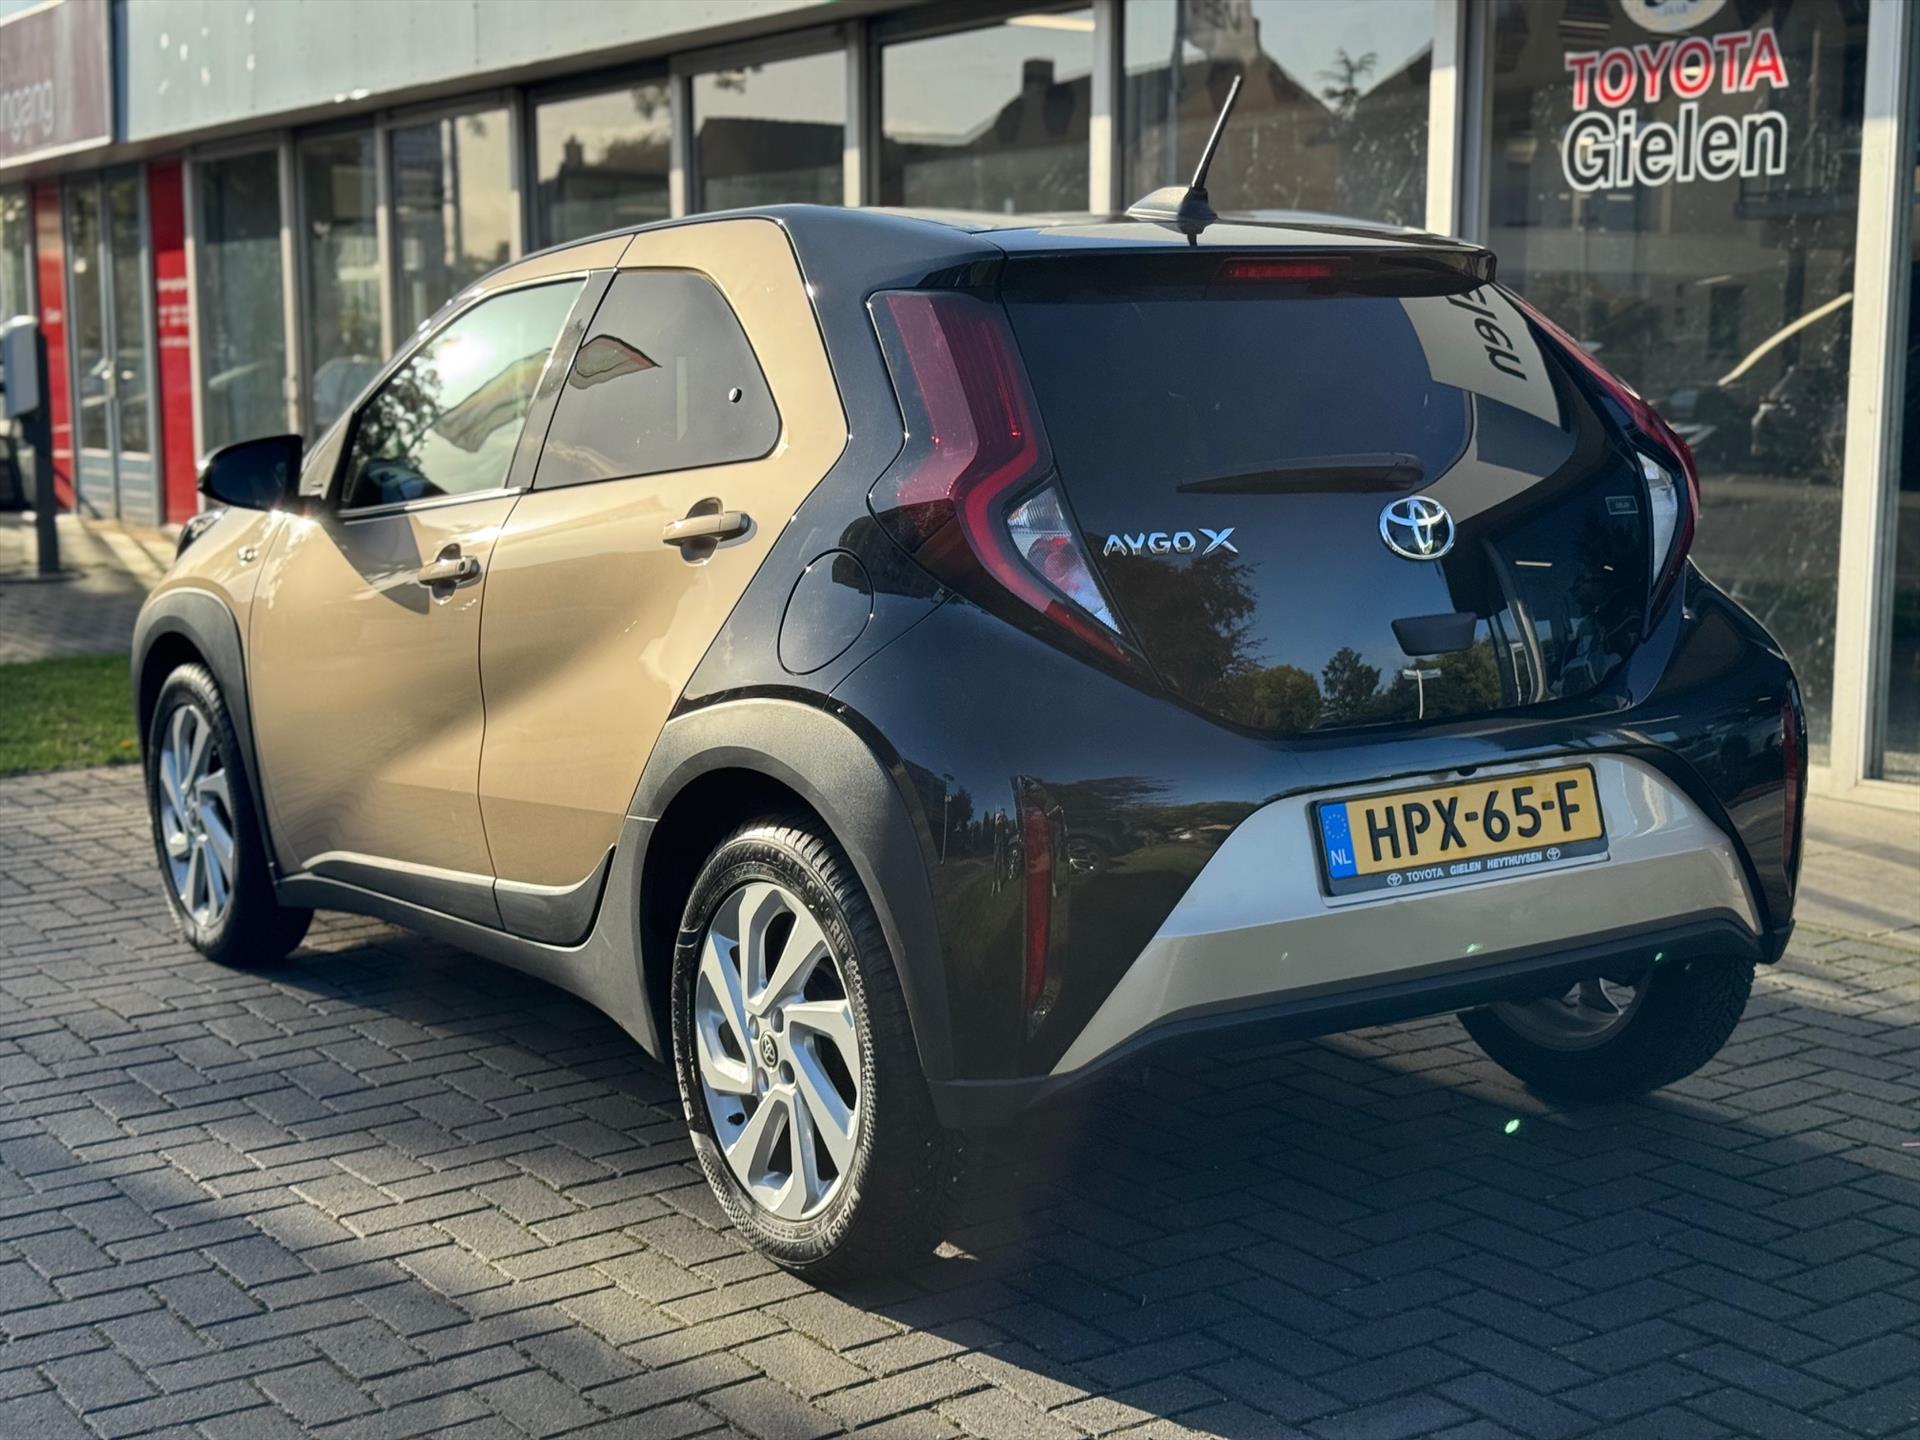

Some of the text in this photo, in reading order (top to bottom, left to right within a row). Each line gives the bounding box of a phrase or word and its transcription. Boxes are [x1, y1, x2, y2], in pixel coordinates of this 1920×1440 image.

[1564, 28, 1789, 111] TOYOTA
[1562, 102, 1788, 191] Gielen
[1103, 527, 1239, 557] AYGO X
[1365, 779, 1580, 861] HPX-65-F
[1330, 848, 1352, 866] NL
[1406, 851, 1542, 882] TOYOTA GIELEN HEYTHUYSEN
